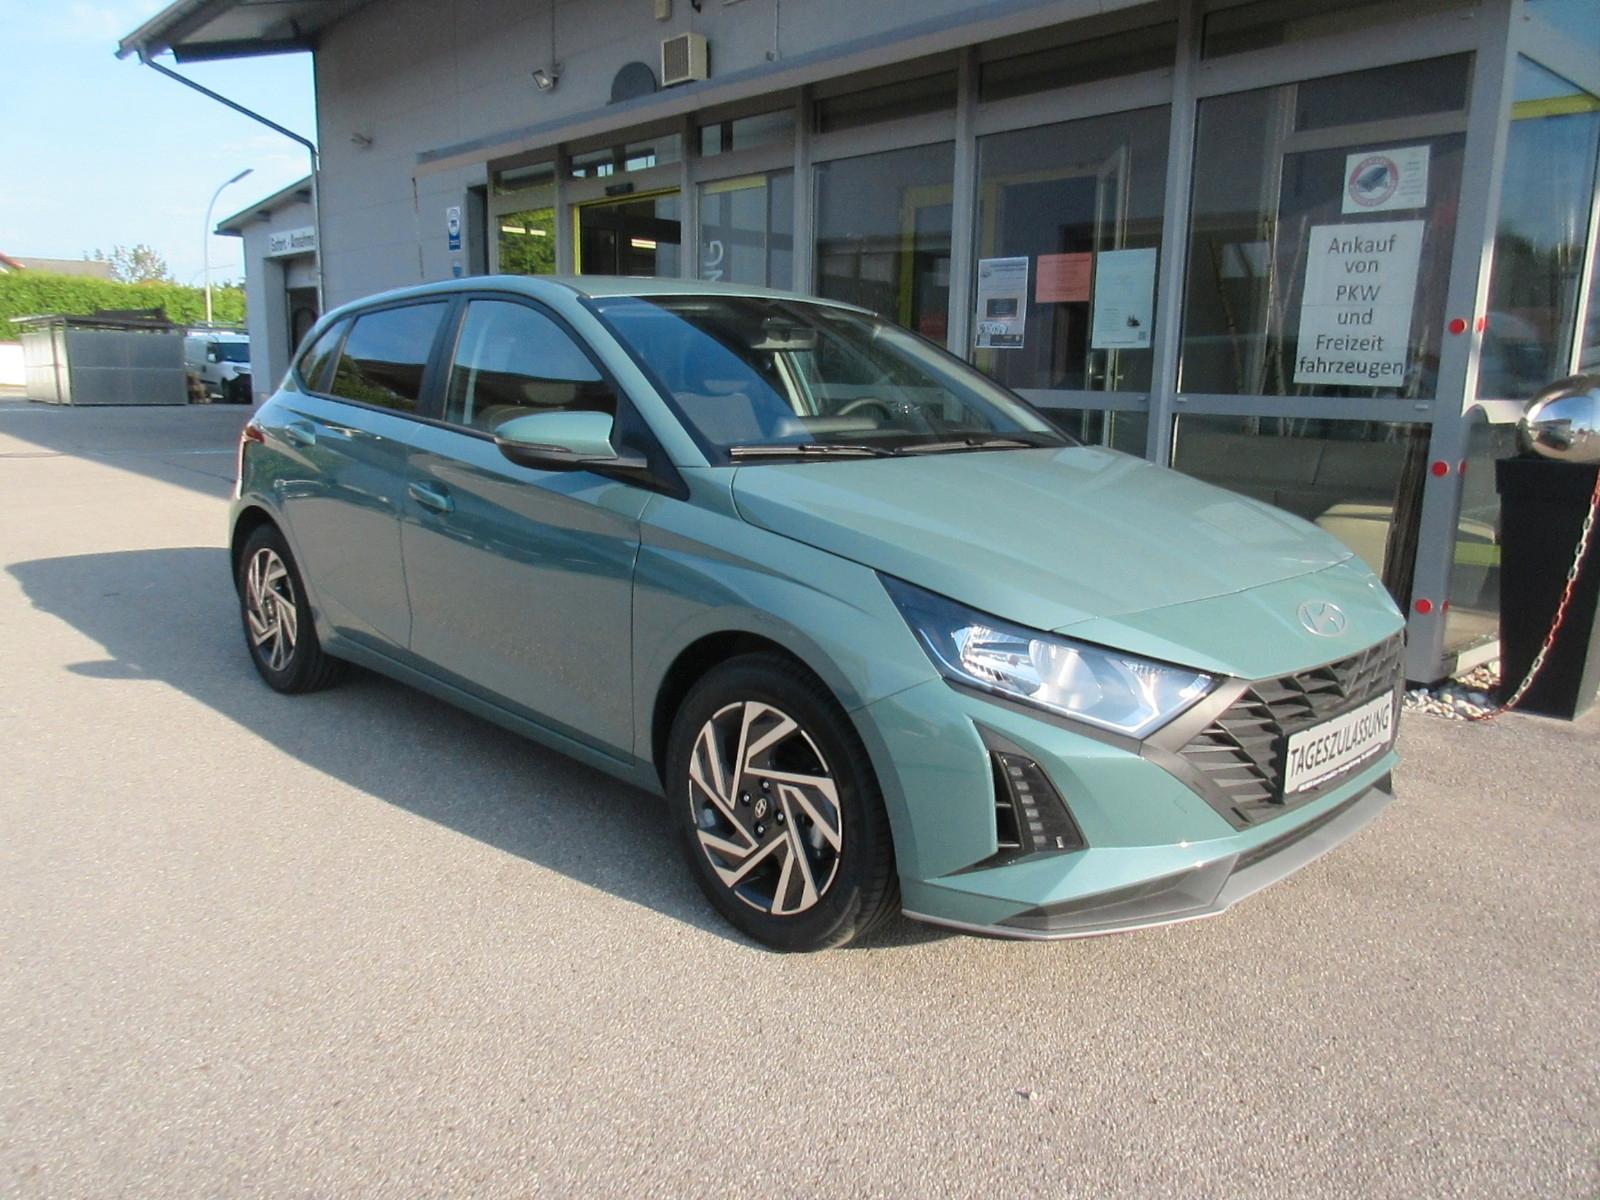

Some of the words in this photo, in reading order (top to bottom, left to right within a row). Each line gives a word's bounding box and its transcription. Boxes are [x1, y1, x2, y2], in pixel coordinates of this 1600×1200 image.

[1328, 234, 1397, 255] Ankauf
[1344, 259, 1379, 274] von
[1335, 285, 1381, 301] PKW
[1337, 308, 1374, 325] und
[1315, 334, 1384, 352] Freizeit
[1299, 357, 1404, 378] fahrzeugen
[1290, 703, 1390, 778] TAGESZULASSUNG
